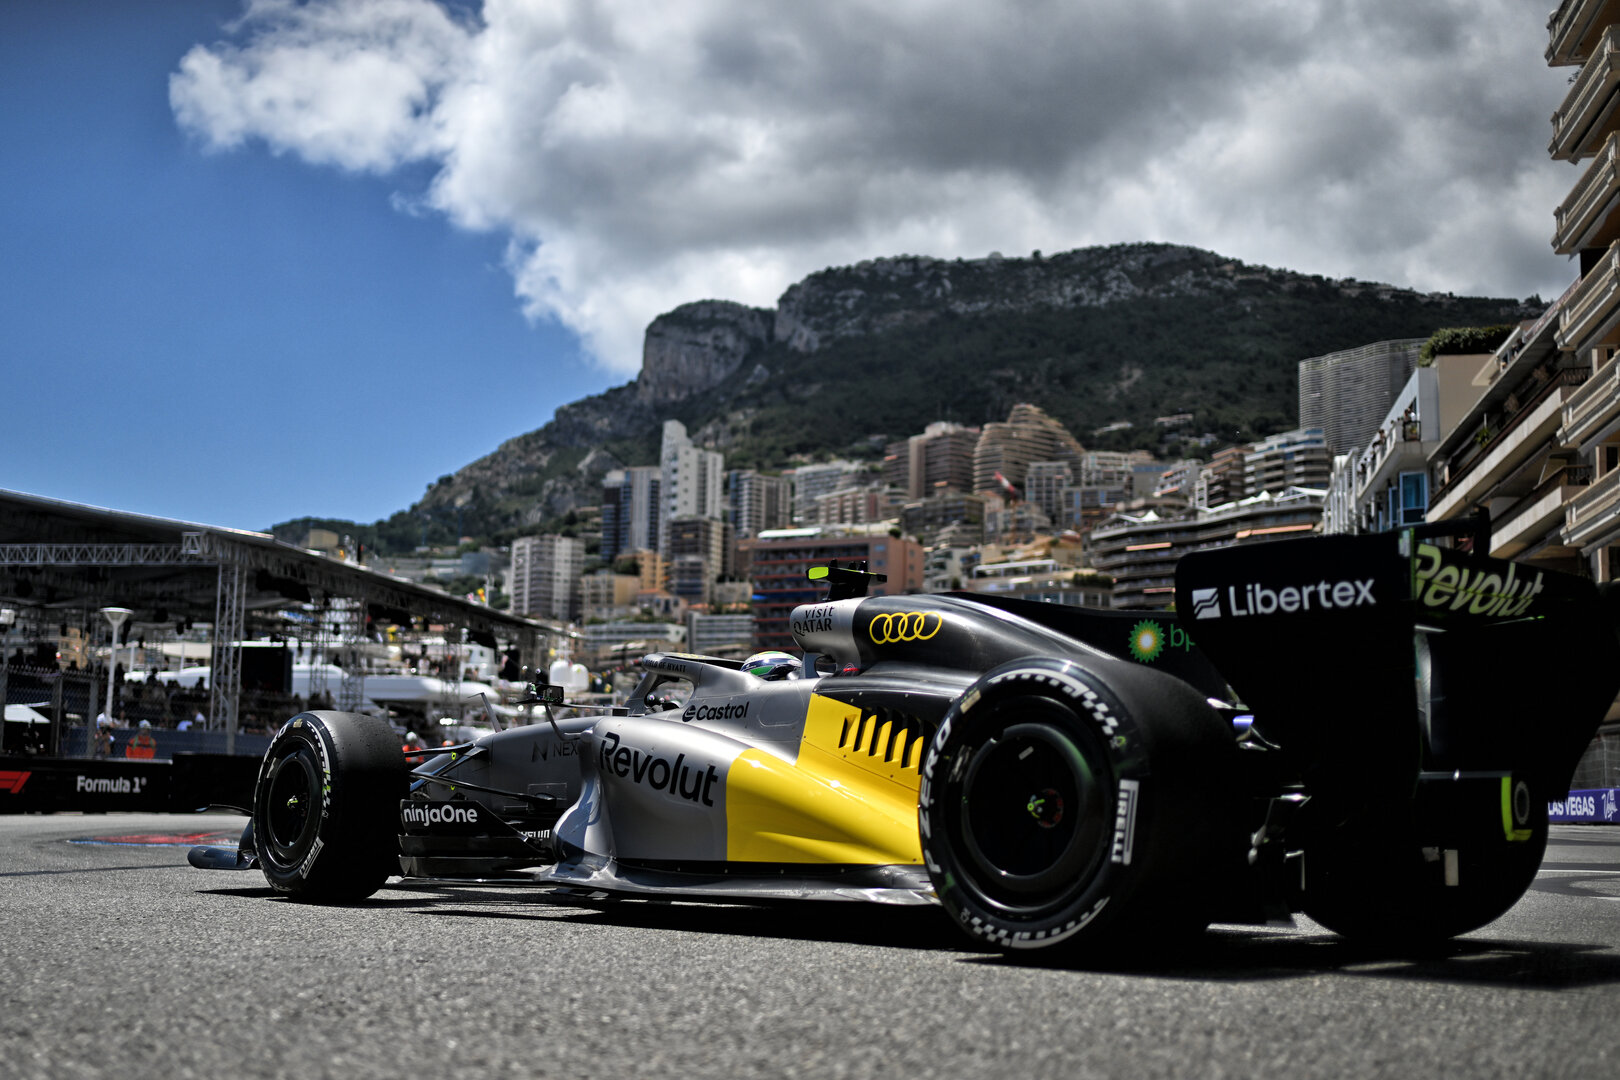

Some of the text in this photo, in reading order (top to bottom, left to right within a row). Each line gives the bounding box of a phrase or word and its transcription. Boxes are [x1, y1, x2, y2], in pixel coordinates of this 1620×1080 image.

[1416, 543, 1544, 617] Revolut
[1229, 578, 1377, 617] Libertex
[805, 605, 835, 619] visit
[793, 618, 833, 637] QATAR
[667, 662, 686, 673] HYATT
[696, 701, 750, 721] Castrol
[553, 741, 579, 757] NEX
[600, 731, 719, 808] Revolut
[919, 717, 952, 839] ZERO
[76, 775, 130, 793] Formula
[403, 803, 478, 827] ninjaOne
[1547, 800, 1564, 816] LAS
[1565, 796, 1596, 817] VEGAS
[1111, 779, 1139, 866] PIRELLI
